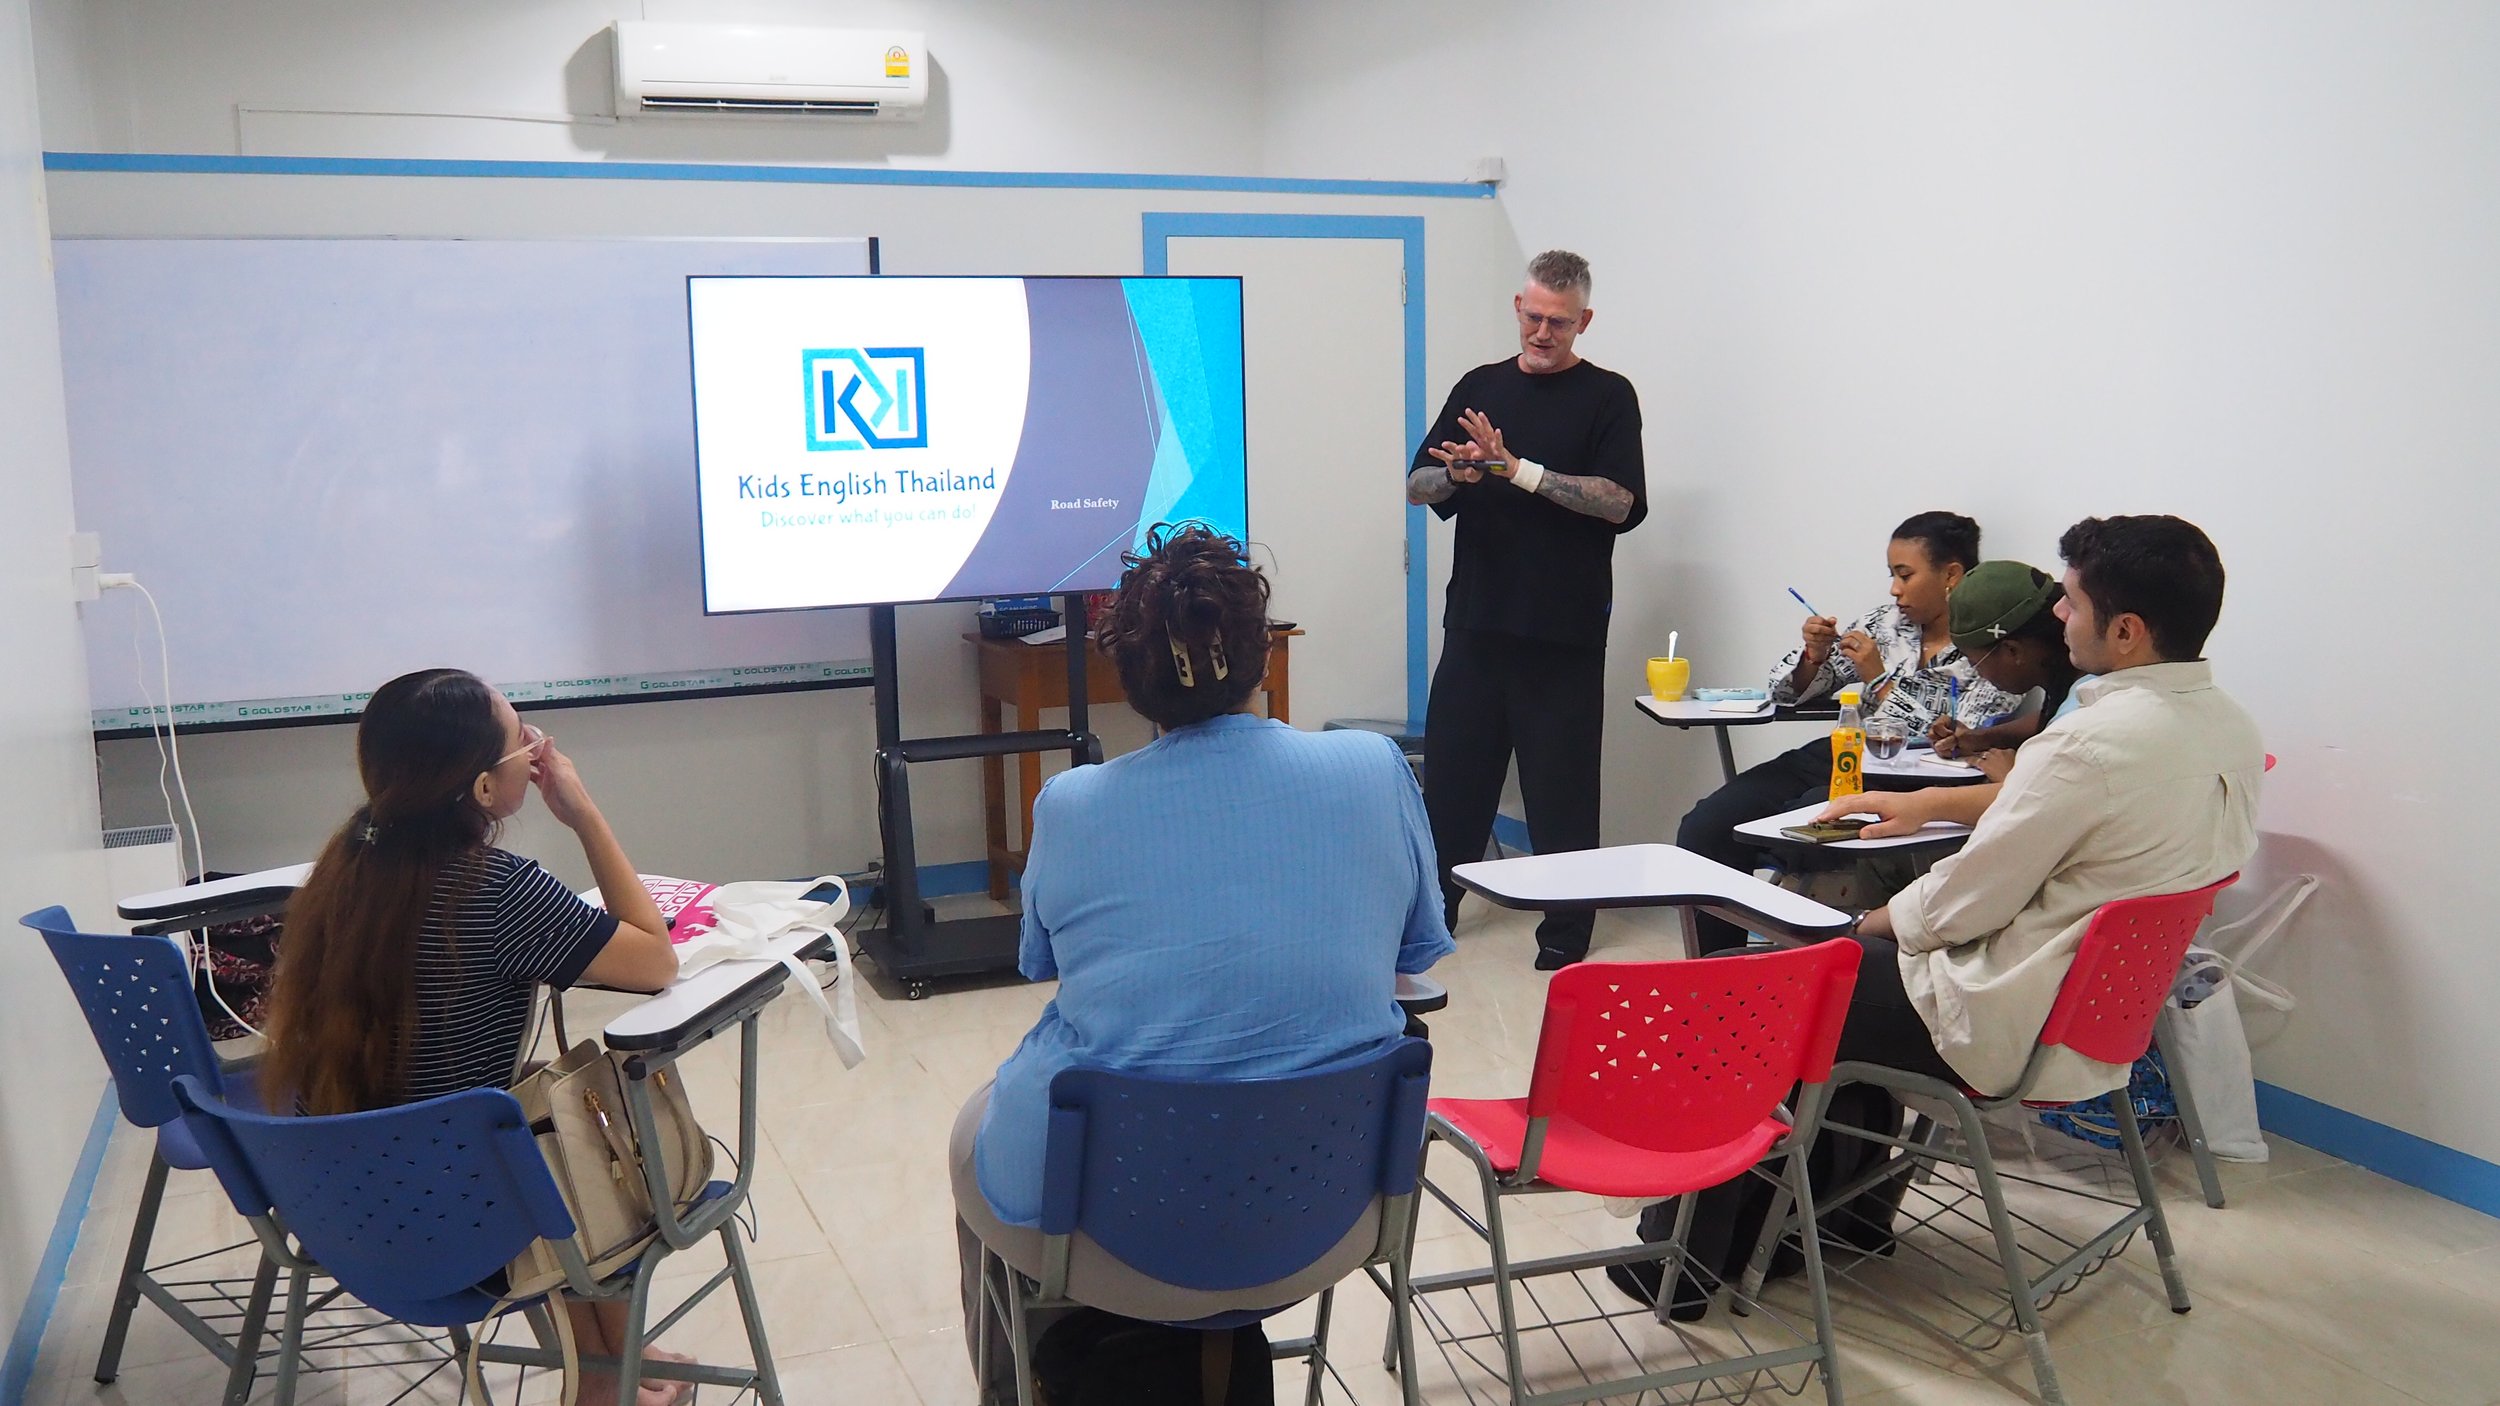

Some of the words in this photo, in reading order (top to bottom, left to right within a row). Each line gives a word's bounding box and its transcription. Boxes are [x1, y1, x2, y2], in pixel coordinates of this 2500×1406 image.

[738, 474, 791, 499] Kids
[800, 471, 887, 504] English
[895, 467, 996, 494] Thailand
[1050, 498, 1081, 510] Road
[1083, 497, 1120, 510] Safety
[761, 510, 833, 528] Discover
[839, 508, 879, 524] what
[884, 510, 913, 528] you
[919, 508, 946, 521] can
[952, 503, 976, 519] do!
[834, 666, 873, 675] GOLDST
[652, 679, 706, 689] GOLDSTAR
[251, 705, 312, 715] GOLDSTAR
